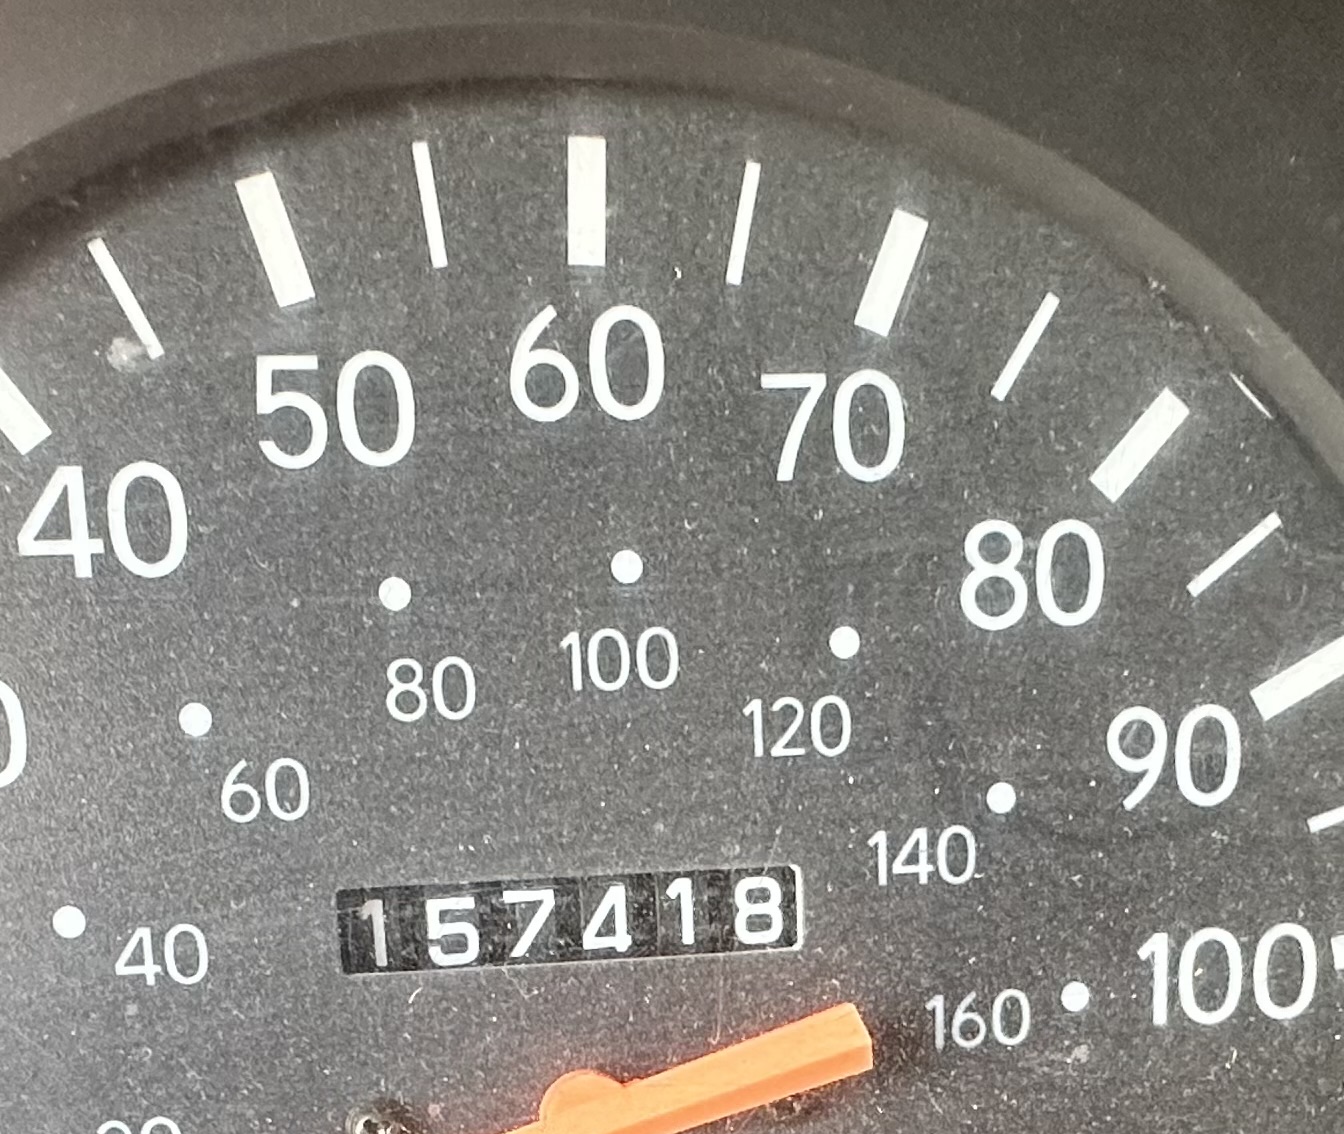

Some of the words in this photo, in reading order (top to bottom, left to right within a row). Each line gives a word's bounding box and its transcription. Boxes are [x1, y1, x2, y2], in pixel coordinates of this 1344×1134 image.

[510, 304, 665, 422] 60
[256, 350, 416, 469] 50
[760, 369, 905, 483] 70
[18, 461, 188, 578] 40
[959, 518, 1106, 631] 80
[385, 656, 476, 722] 80
[560, 626, 681, 692] 100
[741, 694, 852, 757] 120
[1105, 703, 1241, 810] 90
[221, 757, 310, 823] 60
[867, 825, 976, 886] 140
[115, 923, 208, 986] 40
[358, 876, 784, 967] 157418
[925, 988, 1030, 1050] 160
[1137, 922, 1317, 1025] 100
